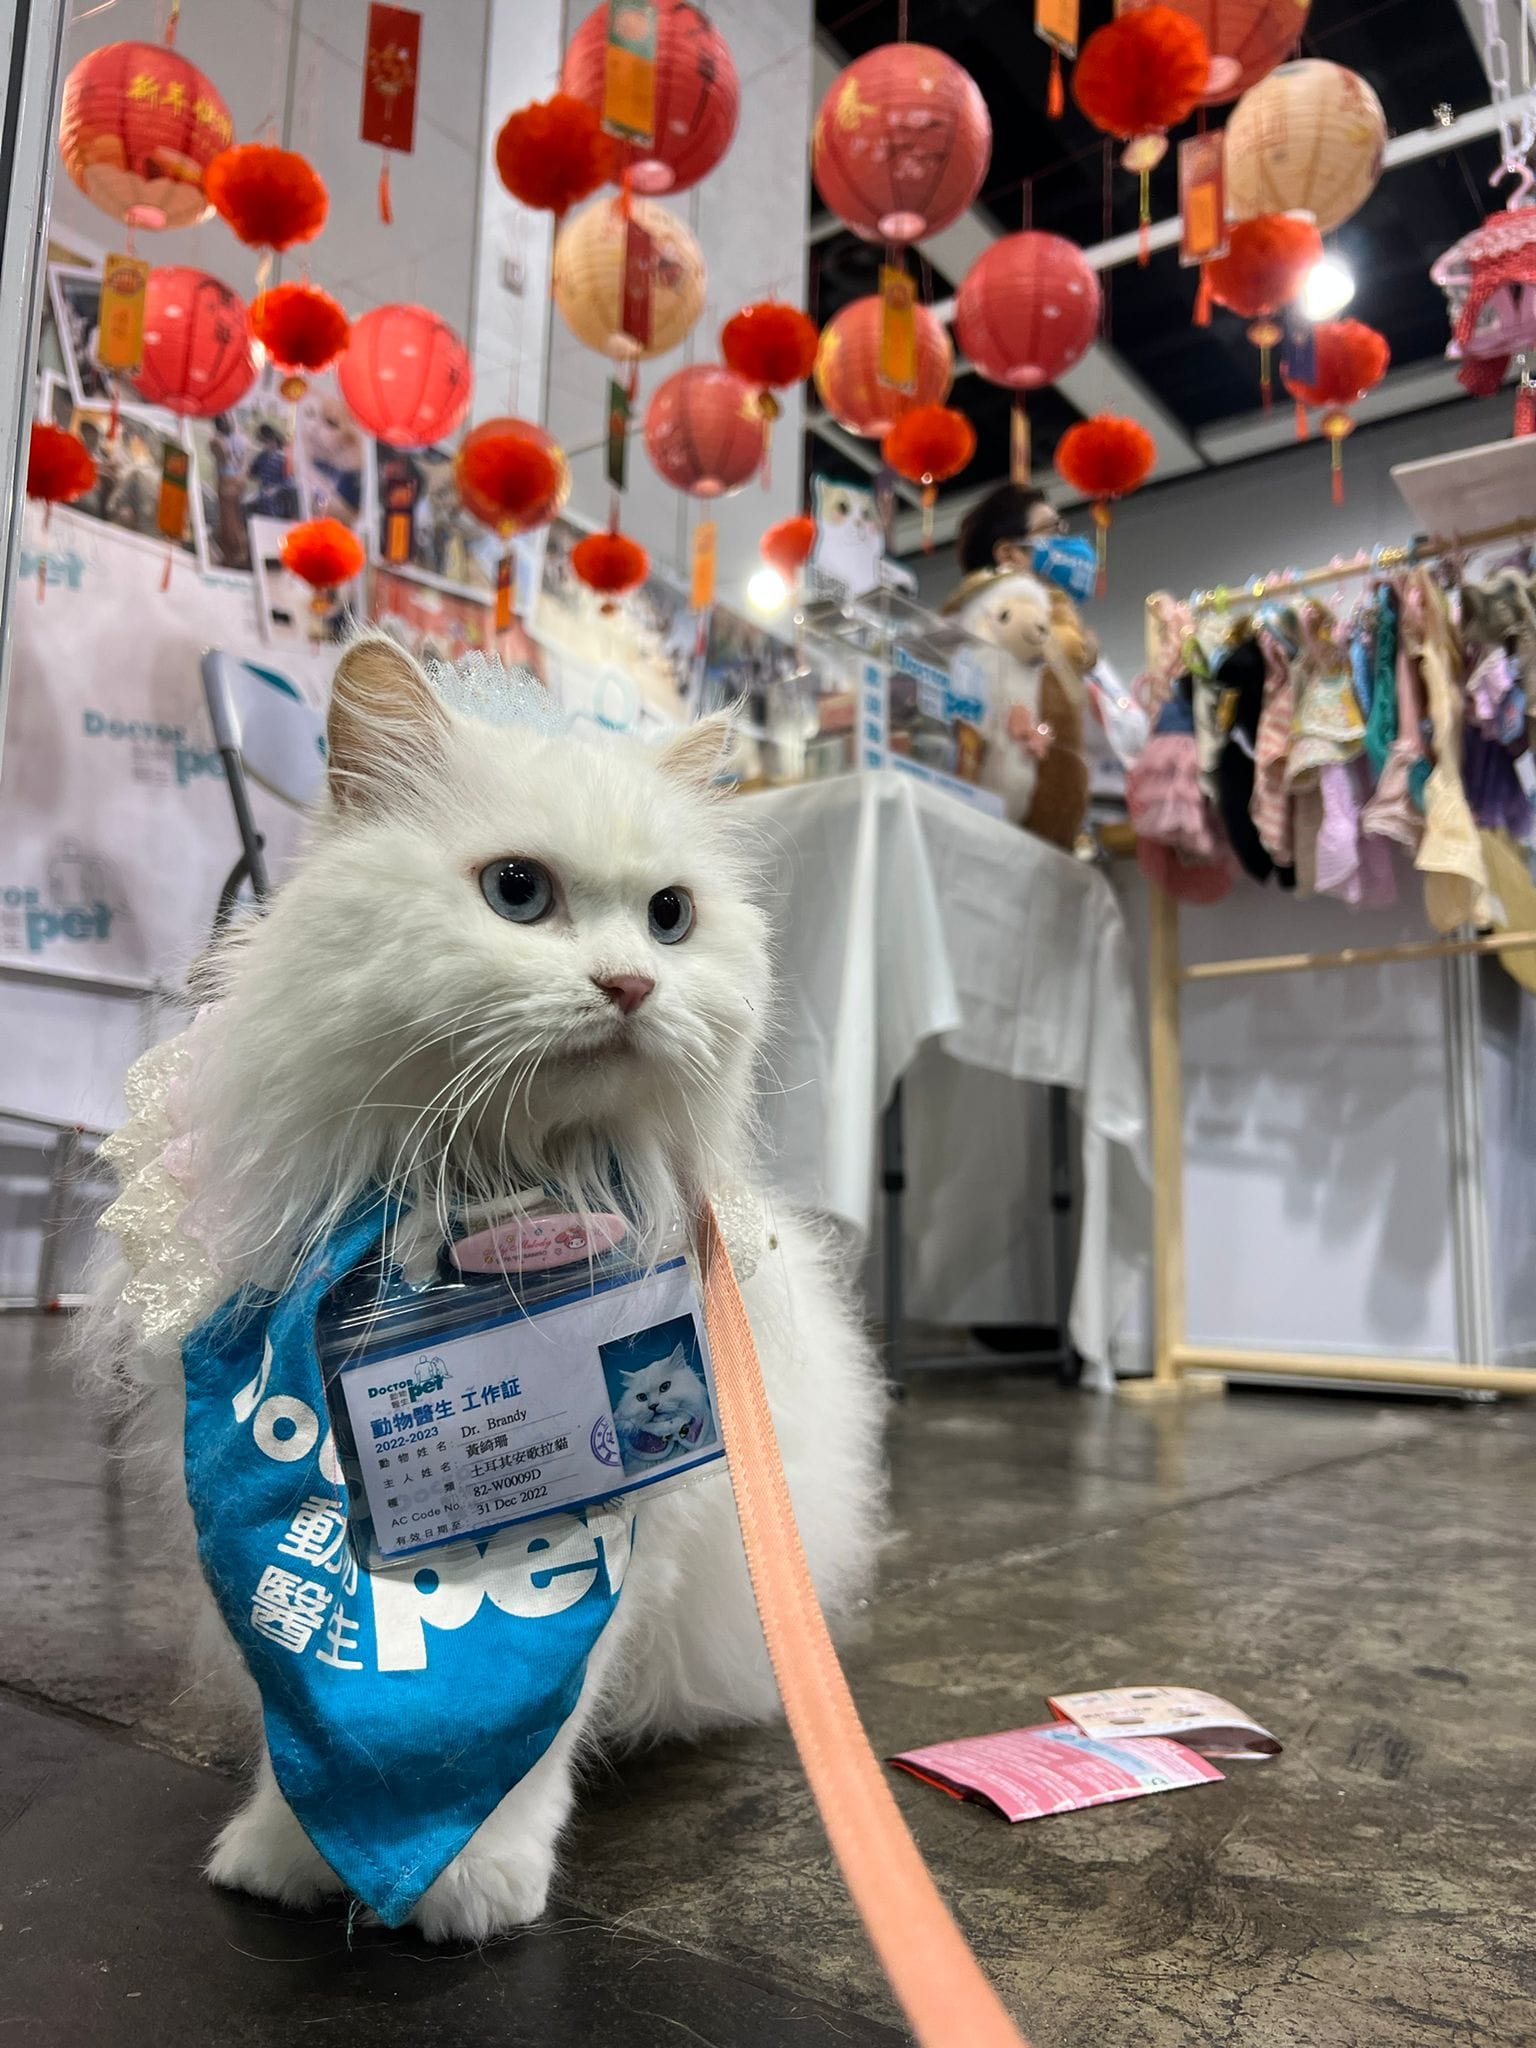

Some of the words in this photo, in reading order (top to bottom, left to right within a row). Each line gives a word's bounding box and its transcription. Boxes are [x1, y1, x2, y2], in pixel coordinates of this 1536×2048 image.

[26, 900, 111, 953] pet
[368, 1378, 413, 1398] DOCTOR
[370, 1399, 455, 1440] 動物醫生
[461, 1377, 523, 1412] 工作証
[461, 1426, 481, 1439] Dr.
[487, 1409, 527, 1431] Brandy
[375, 1426, 440, 1454] 2022-2023
[391, 1516, 408, 1528] AC
[411, 1508, 442, 1522] Code
[473, 1468, 543, 1498] 82-W0009D
[476, 1502, 491, 1516] 31
[494, 1495, 517, 1511] Dec
[519, 1485, 549, 1504] 2022
